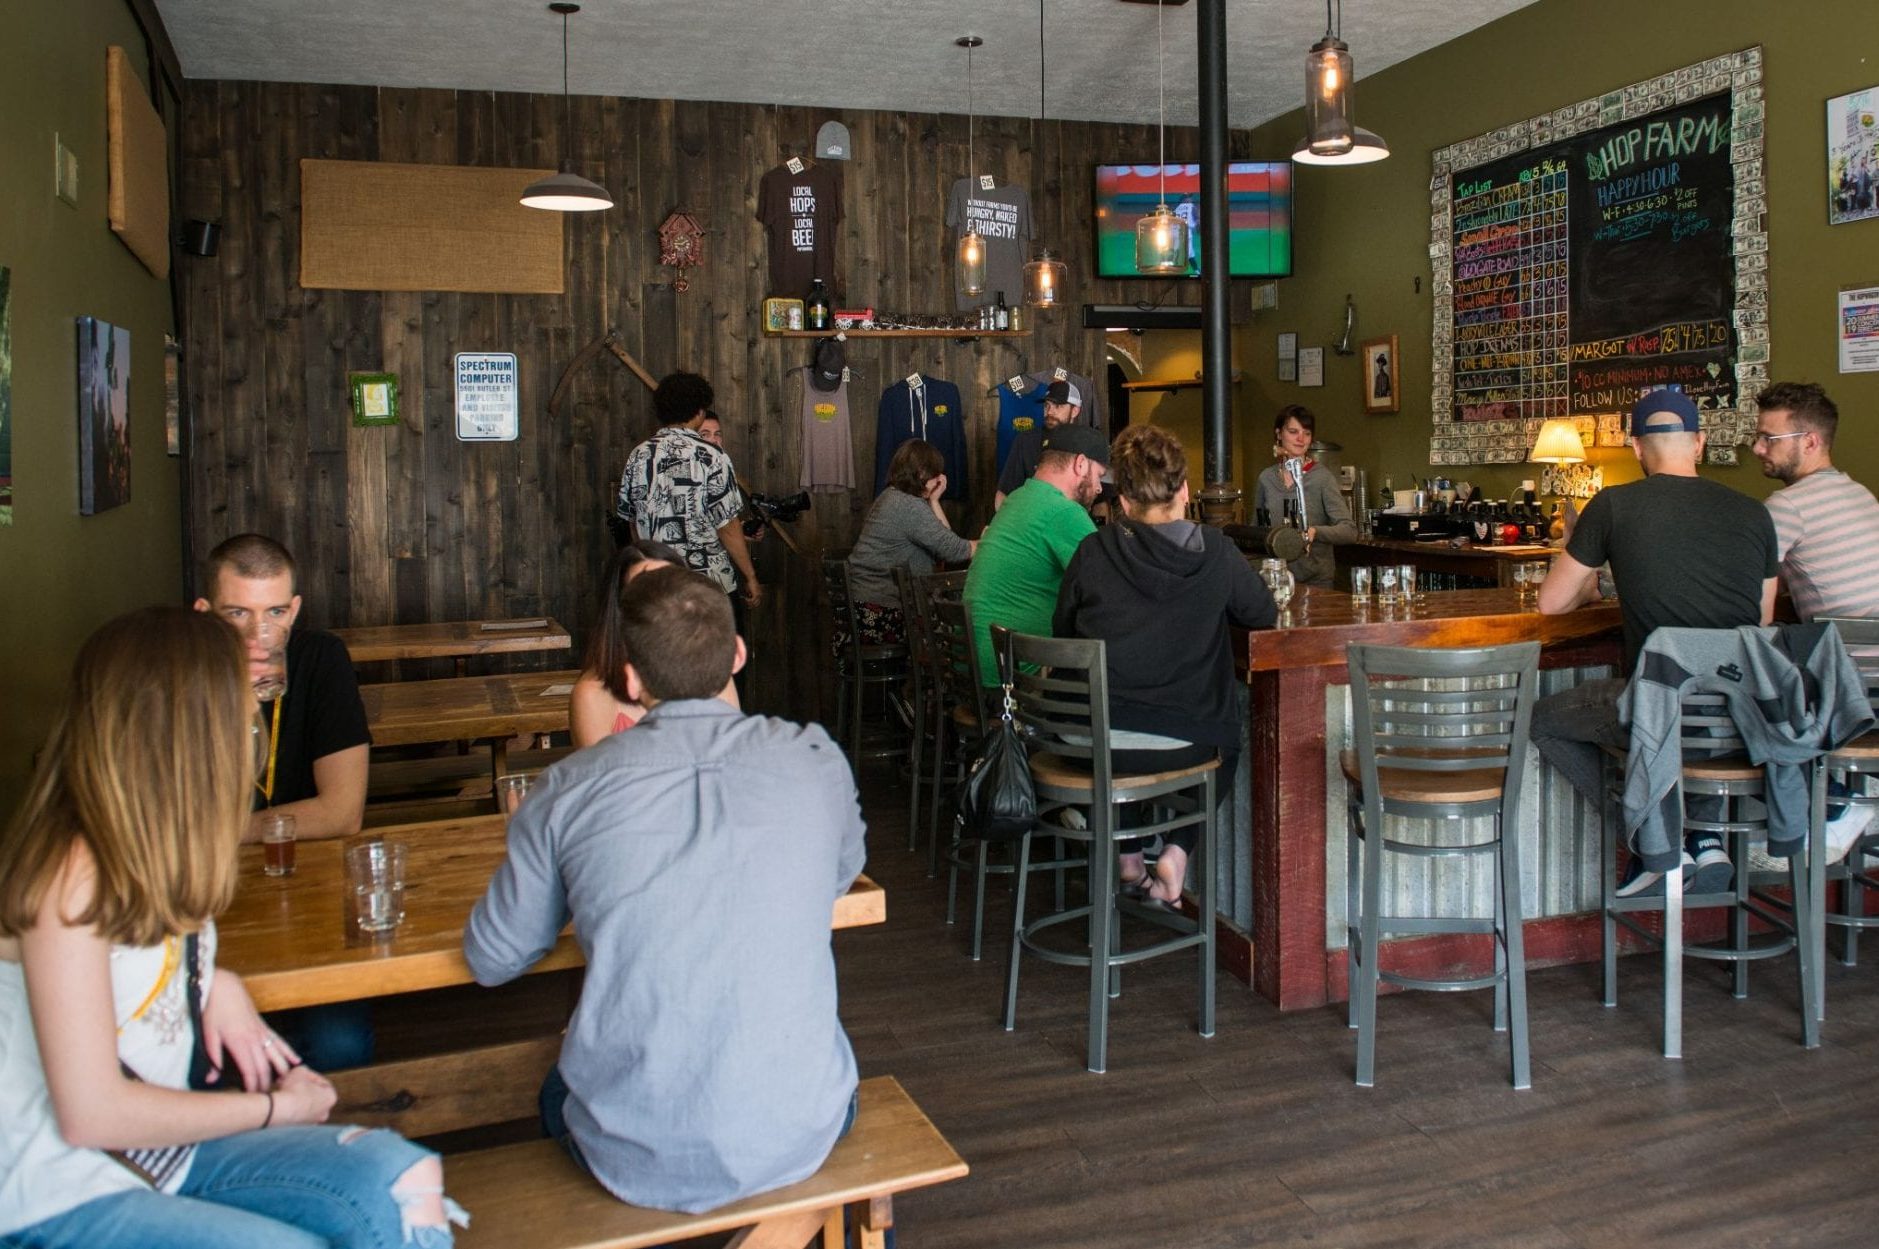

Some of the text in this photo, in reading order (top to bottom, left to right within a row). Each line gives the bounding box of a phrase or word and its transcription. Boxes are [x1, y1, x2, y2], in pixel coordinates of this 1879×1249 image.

[1600, 114, 1719, 177] HOP FARM
[793, 186, 813, 197] LOCAL
[1597, 162, 1681, 207] HAPPY HOUR
[790, 197, 816, 213] HOPS
[995, 210, 1017, 224] NAKED
[975, 219, 1016, 239] THIRSTY!
[792, 229, 814, 246] BEE
[460, 361, 512, 371] SPECTRUM
[1655, 366, 1669, 380] NO
[460, 373, 512, 383] COMPUTER
[1574, 389, 1613, 410] FOLLOW
